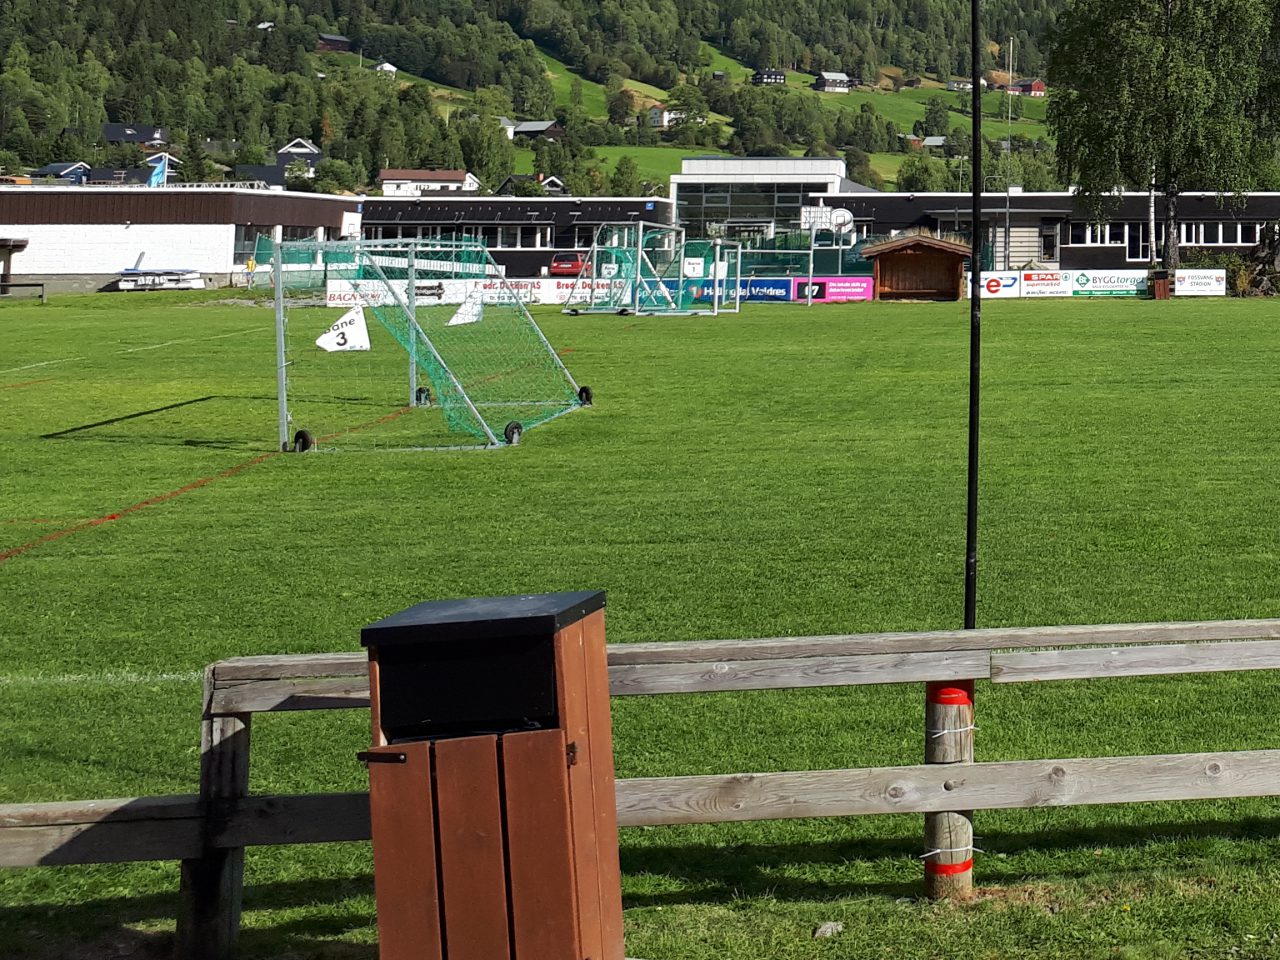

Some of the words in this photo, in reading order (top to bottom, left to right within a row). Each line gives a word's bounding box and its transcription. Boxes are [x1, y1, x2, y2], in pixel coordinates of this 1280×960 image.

[1092, 276, 1145, 286] BYGGtorget
[752, 287, 787, 296] Valdres
[328, 293, 357, 301] BAGN
[336, 331, 348, 346] 3
